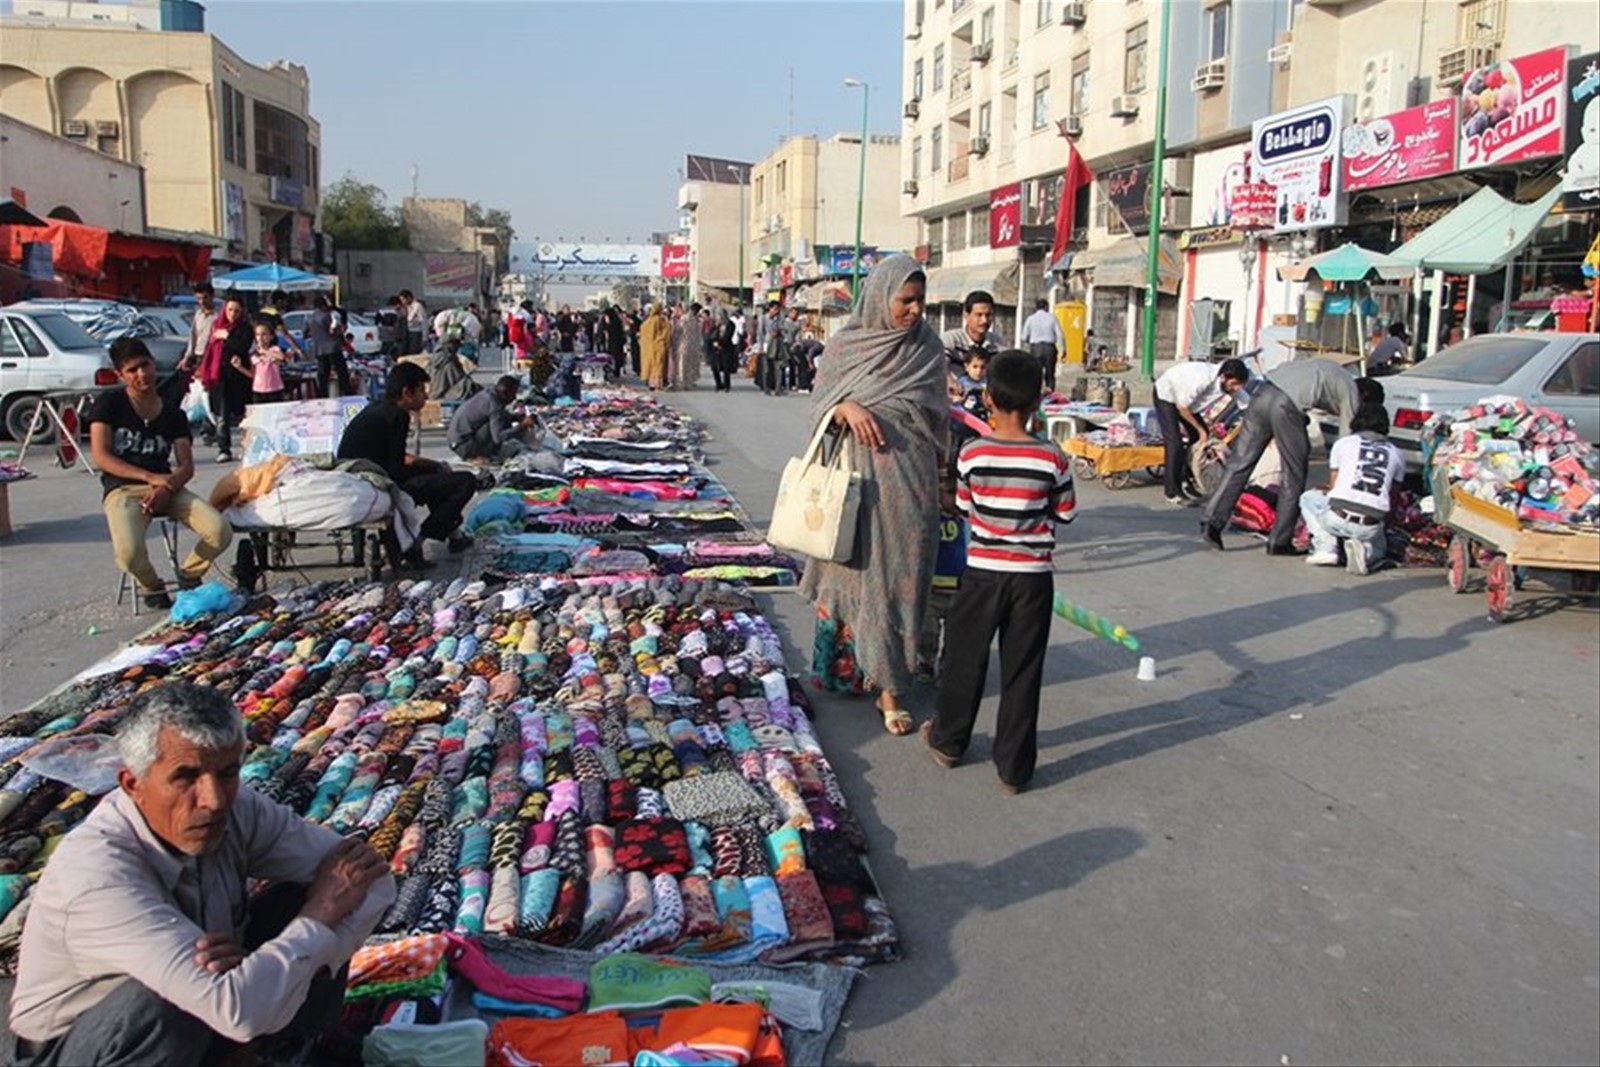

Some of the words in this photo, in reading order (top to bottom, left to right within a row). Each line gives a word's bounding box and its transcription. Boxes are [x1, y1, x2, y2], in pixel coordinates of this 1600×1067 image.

[1523, 69, 1560, 98] بستنی
[1467, 96, 1556, 165] مسعود
[1350, 142, 1409, 178] یاقوت
[531, 248, 639, 271] عسکریه
